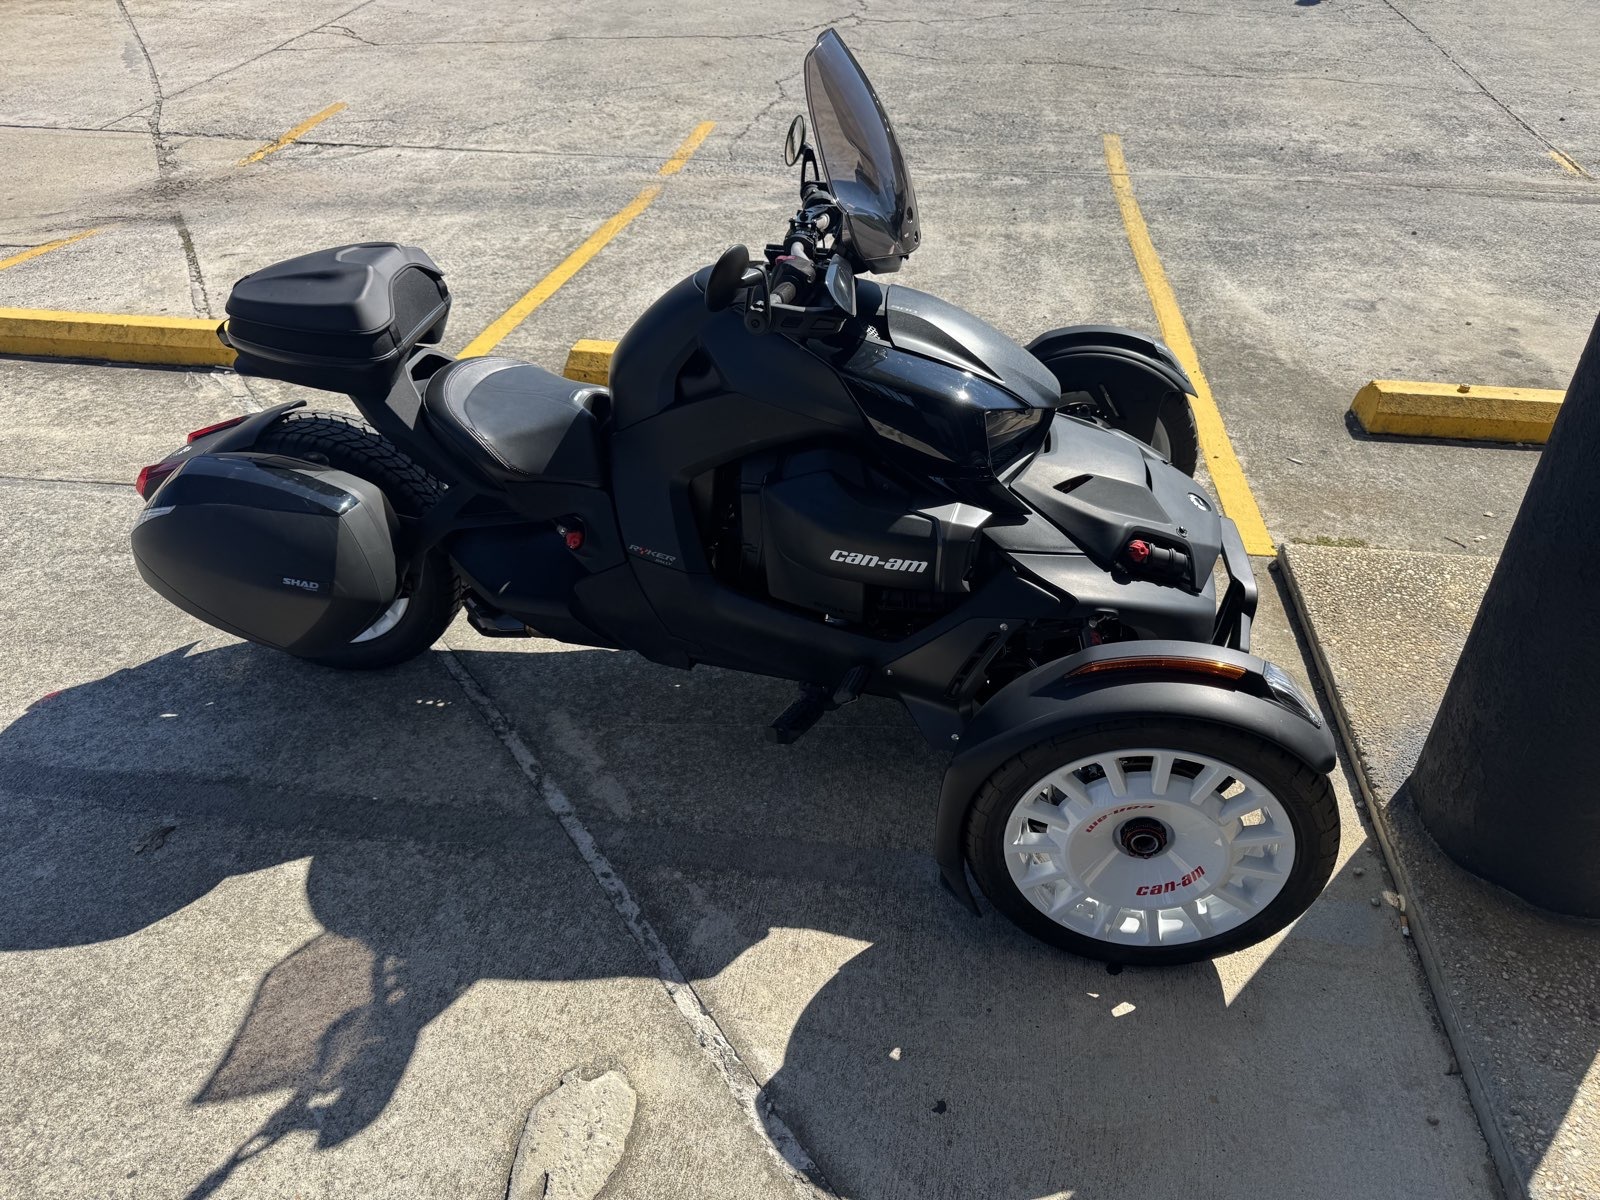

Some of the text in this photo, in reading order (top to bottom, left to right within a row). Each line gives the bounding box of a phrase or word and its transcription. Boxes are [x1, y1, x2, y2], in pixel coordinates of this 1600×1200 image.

[628, 544, 676, 561] RYKER
[829, 549, 928, 573] can-am
[282, 577, 319, 589] SHAD
[1086, 805, 1155, 833] can-am
[1136, 865, 1205, 896] can-am
